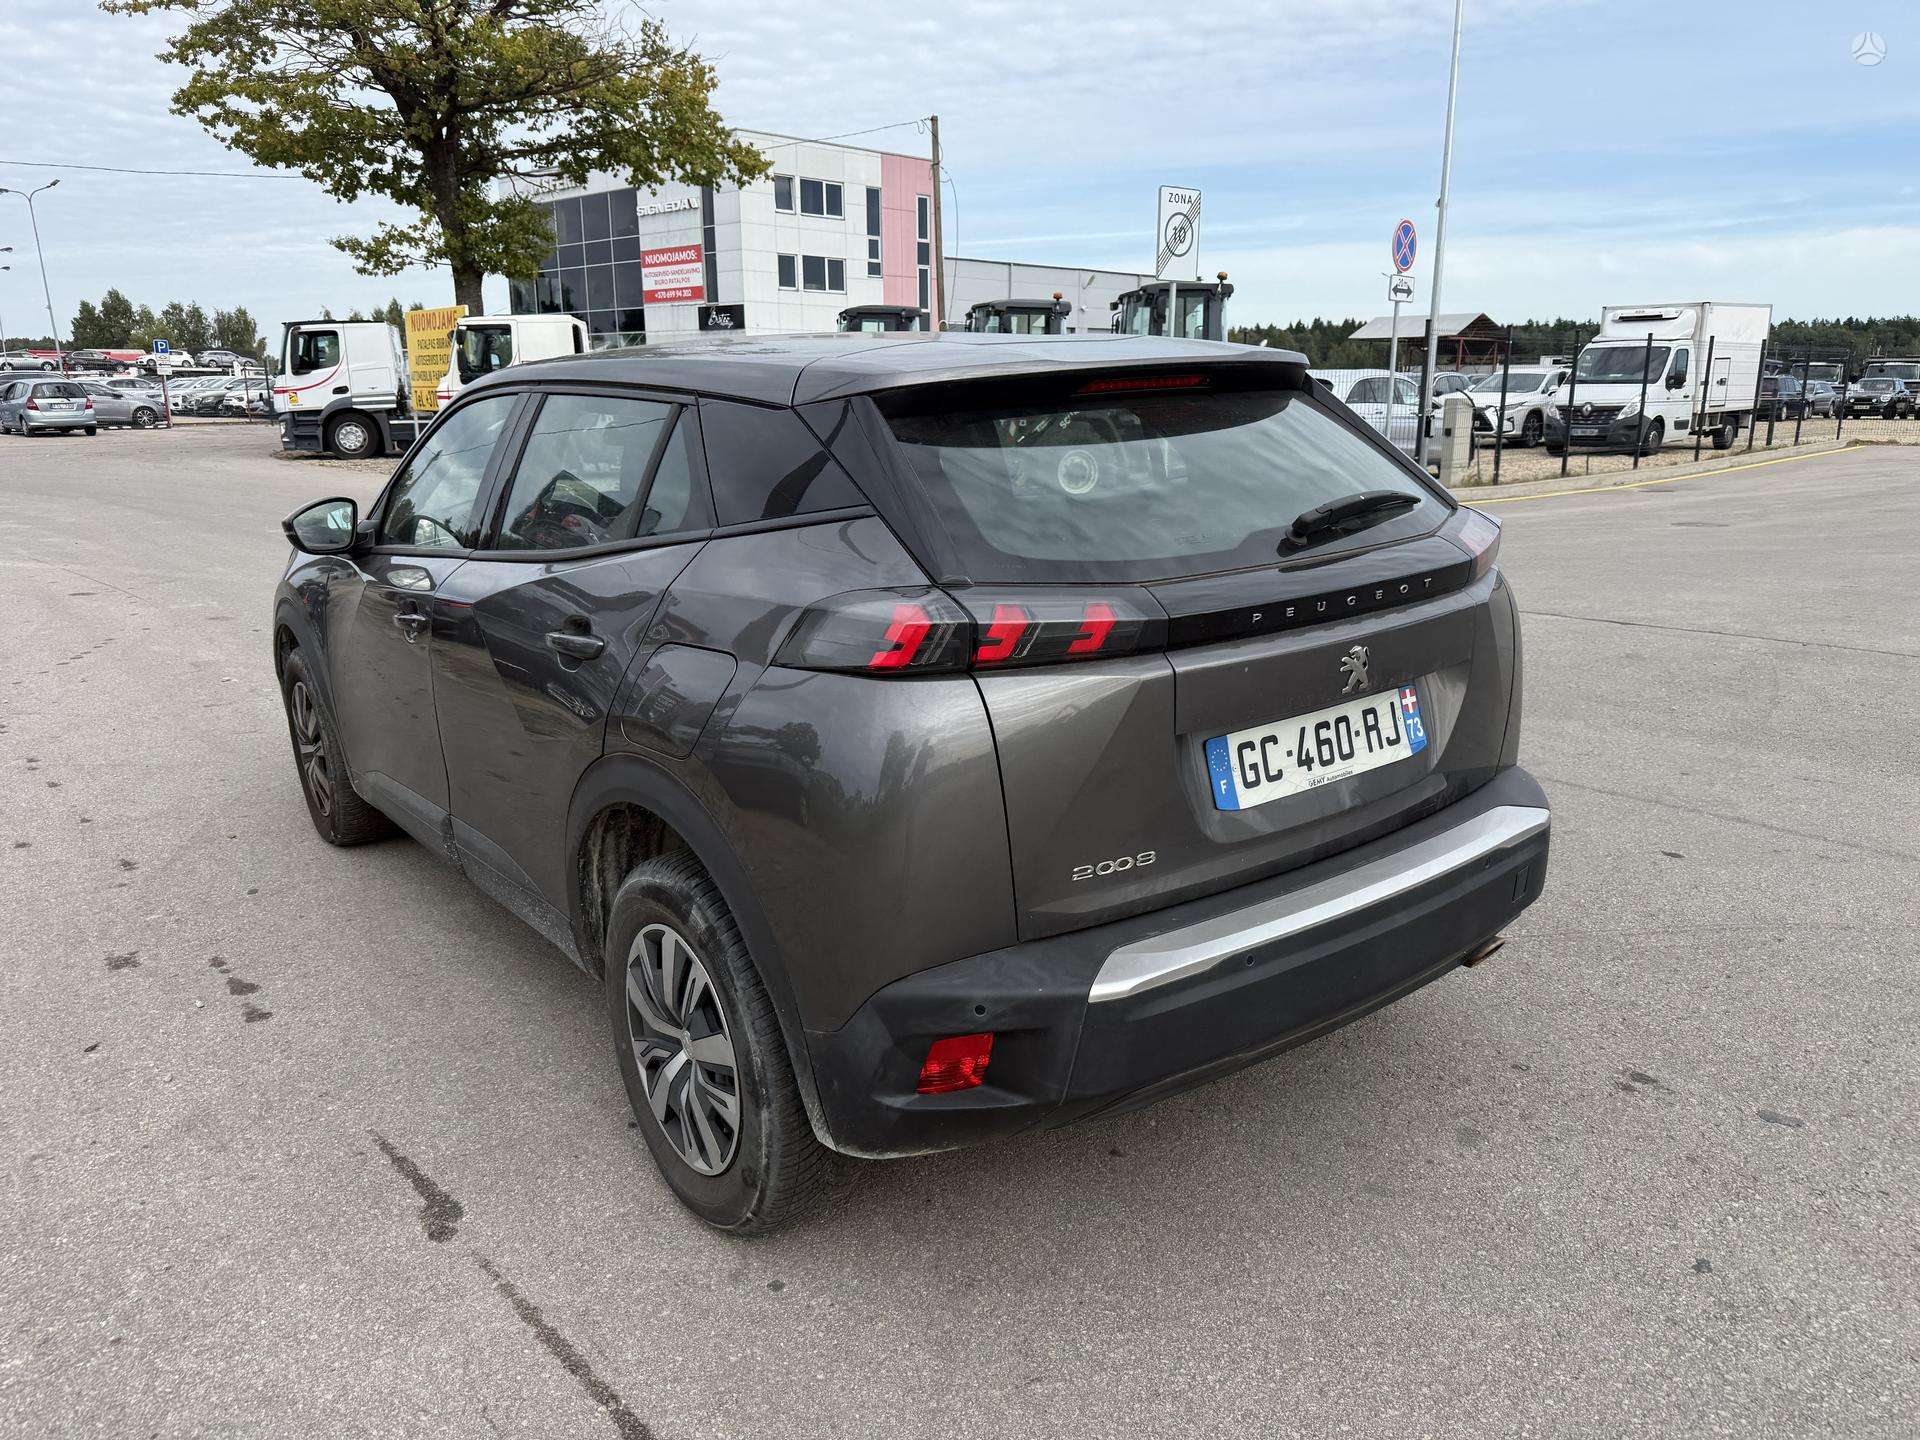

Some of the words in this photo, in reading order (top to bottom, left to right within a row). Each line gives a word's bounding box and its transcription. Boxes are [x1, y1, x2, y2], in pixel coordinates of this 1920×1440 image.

[1168, 192, 1193, 205] ZONA
[1172, 225, 1187, 244] 10
[645, 249, 698, 265] NUOMOJAMOS:
[157, 341, 166, 352] P
[1252, 577, 1432, 623] PEUGEOT
[1406, 716, 1424, 740] 73
[1219, 779, 1228, 795] F
[1072, 851, 1156, 880] 2008
